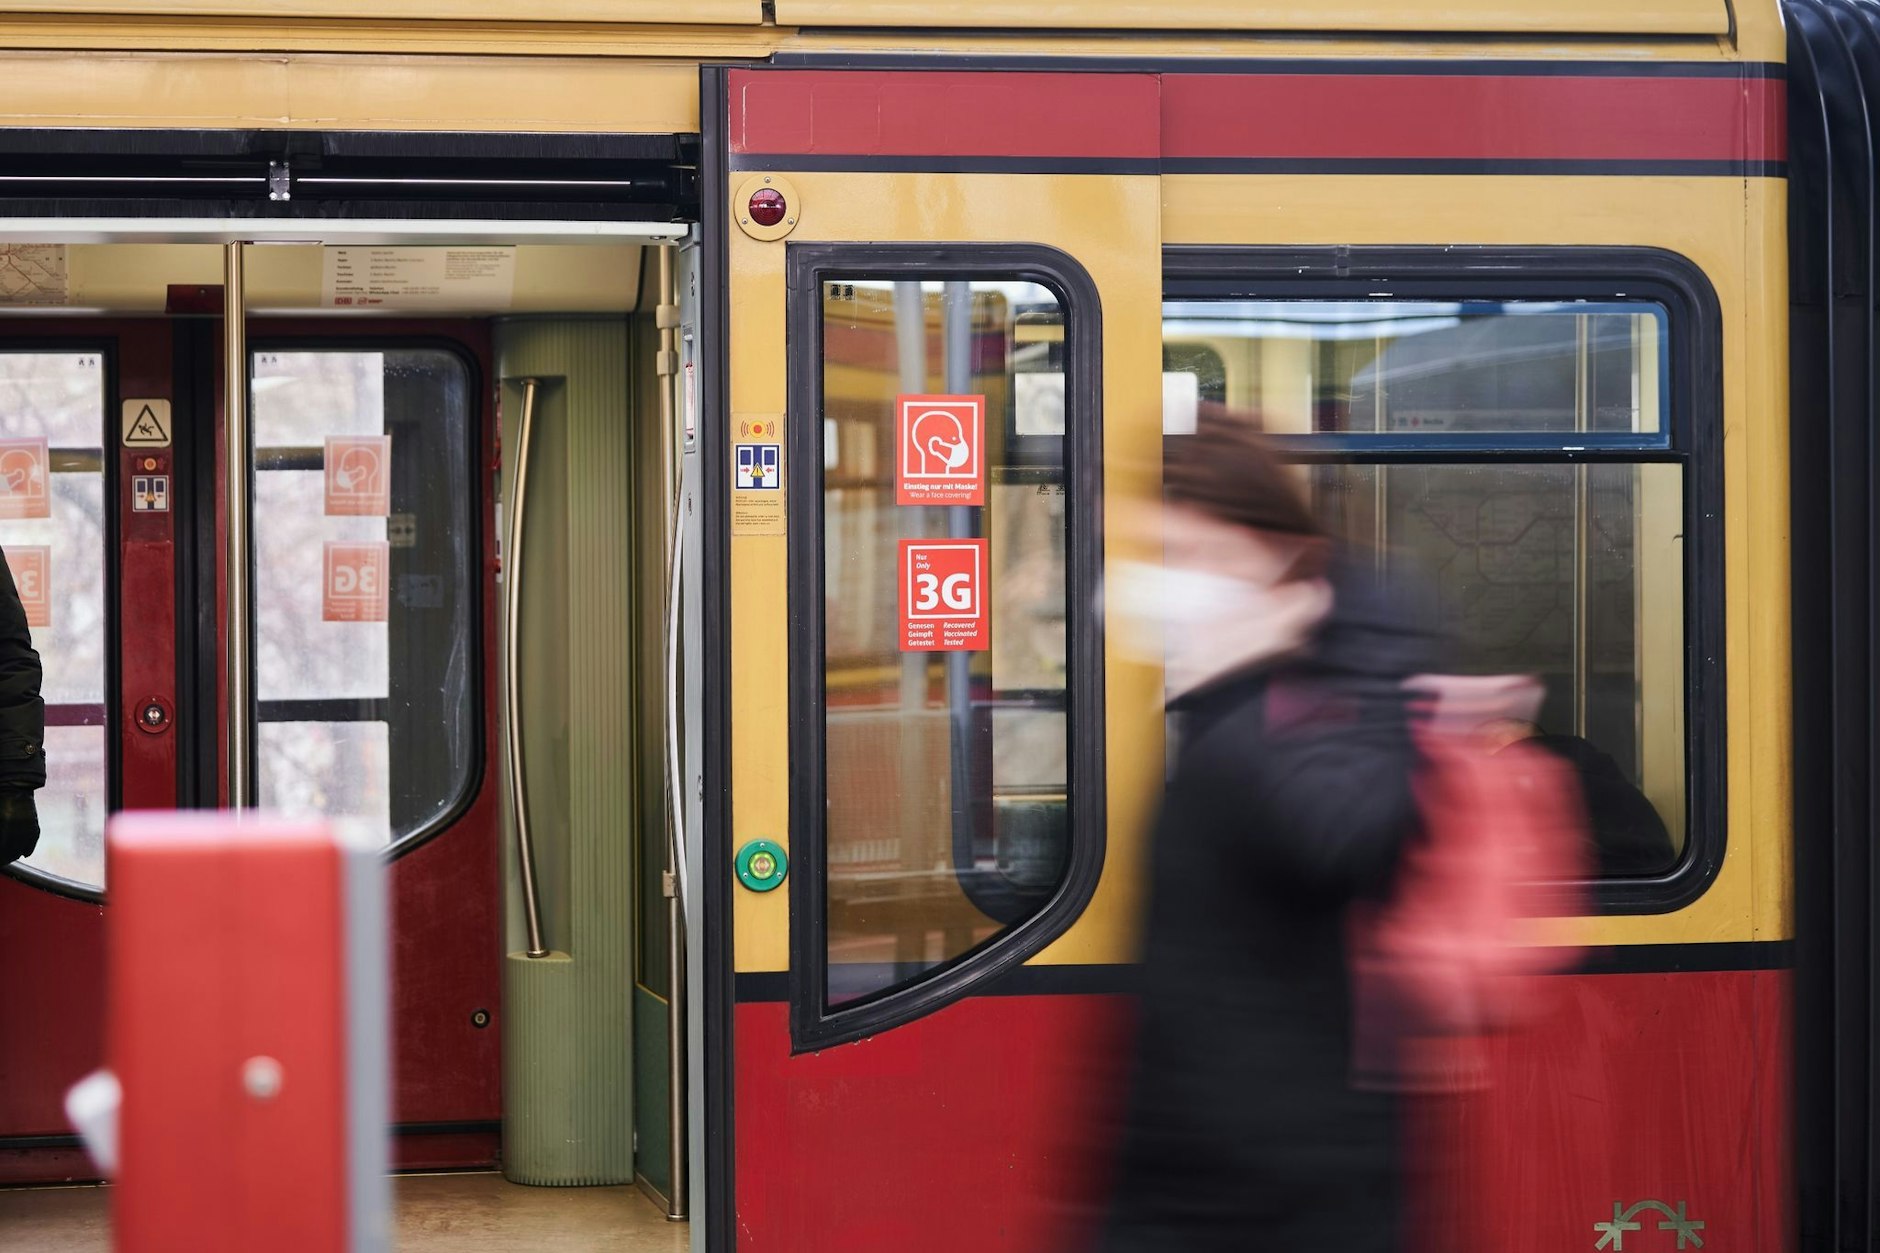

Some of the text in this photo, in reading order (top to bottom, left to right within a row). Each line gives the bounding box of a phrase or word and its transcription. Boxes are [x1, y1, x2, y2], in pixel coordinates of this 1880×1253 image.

[903, 482, 930, 491] Einstieg
[943, 482, 953, 490] mit
[954, 482, 978, 490] Maske!
[944, 492, 972, 500] covering!
[916, 562, 931, 570] Only
[916, 572, 972, 611] 3G
[943, 621, 976, 629] Recovered
[908, 630, 934, 638] Geimpft
